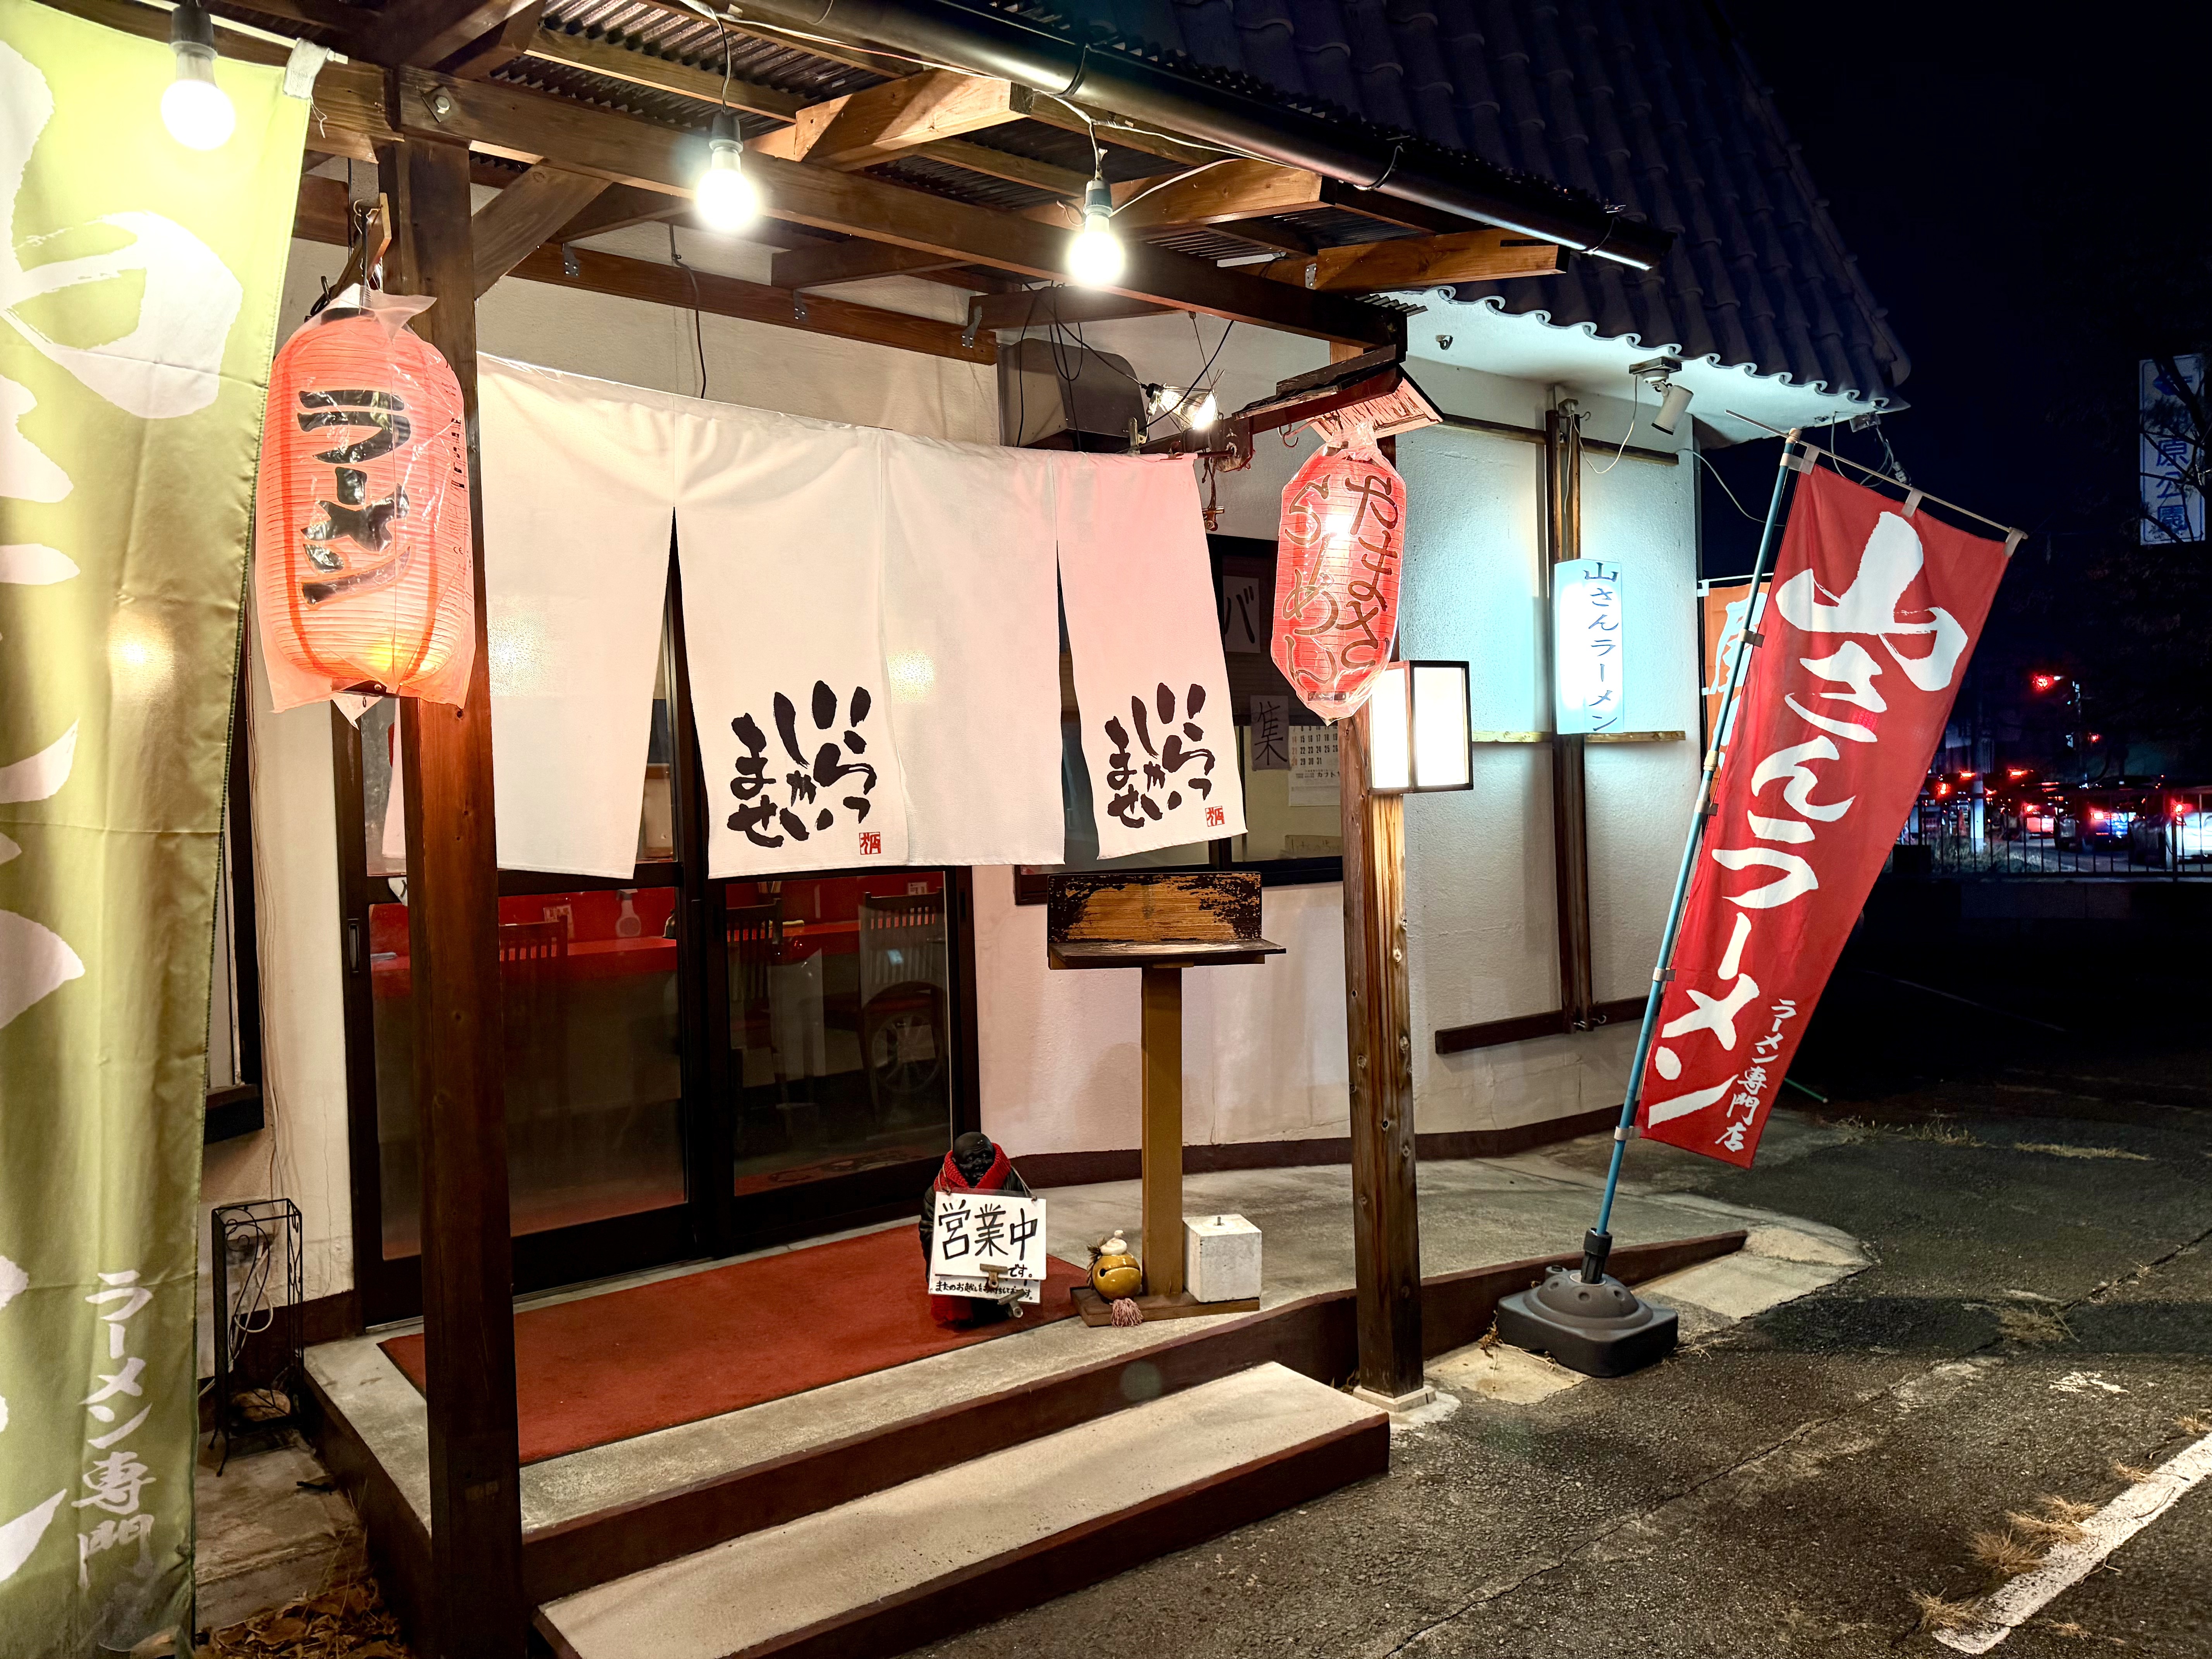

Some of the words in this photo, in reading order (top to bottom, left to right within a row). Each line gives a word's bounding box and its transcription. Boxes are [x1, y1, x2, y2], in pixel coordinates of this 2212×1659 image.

[297, 390, 411, 605] ラーメン
[1583, 562, 1619, 732] 山さんラーメン
[1255, 701, 1287, 765] 集
[1648, 512, 1968, 1129] 山さんラーメン
[1715, 998, 1797, 1152] ラーメン専門店
[938, 1199, 1038, 1261] 営業中
[1008, 1264, 1032, 1278] です。
